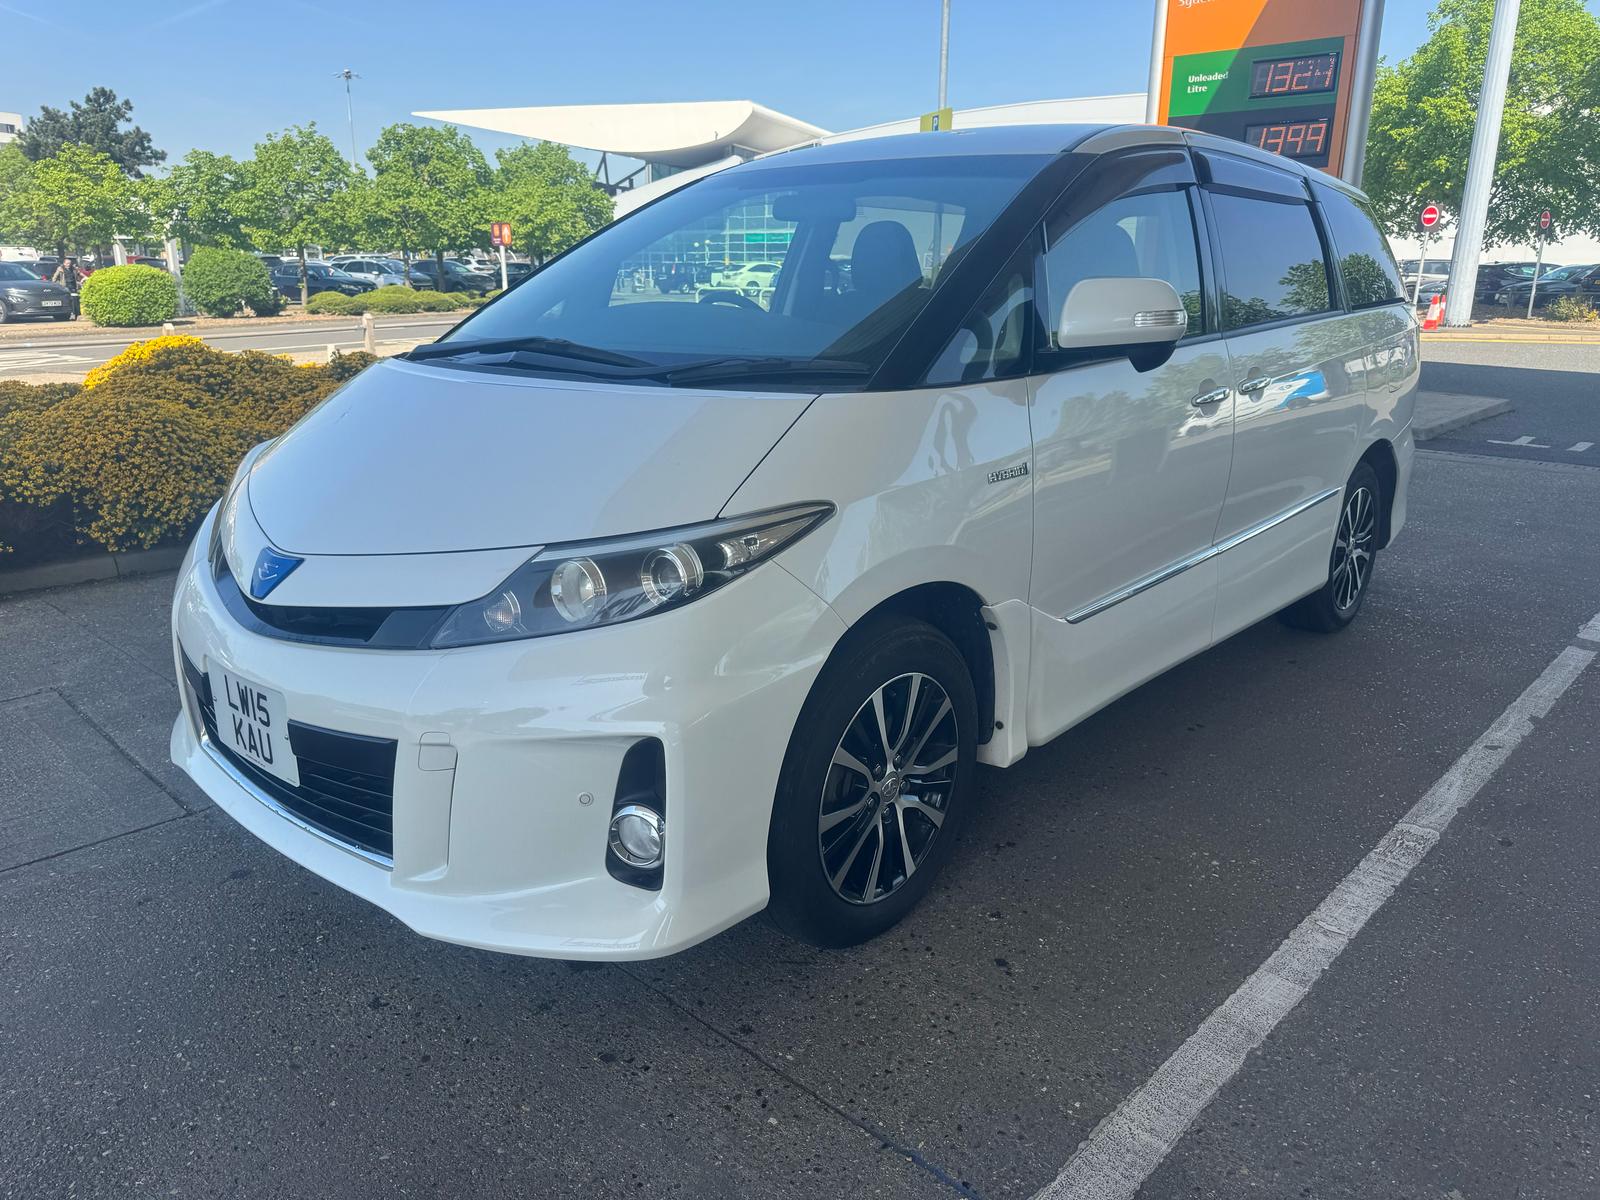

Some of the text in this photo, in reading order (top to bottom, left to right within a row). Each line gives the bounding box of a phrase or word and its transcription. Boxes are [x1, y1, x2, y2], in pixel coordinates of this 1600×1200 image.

[1187, 85, 1208, 93] Litre
[1188, 71, 1229, 83] Unleaded
[224, 673, 271, 728] LW15
[231, 713, 274, 765] KAU
